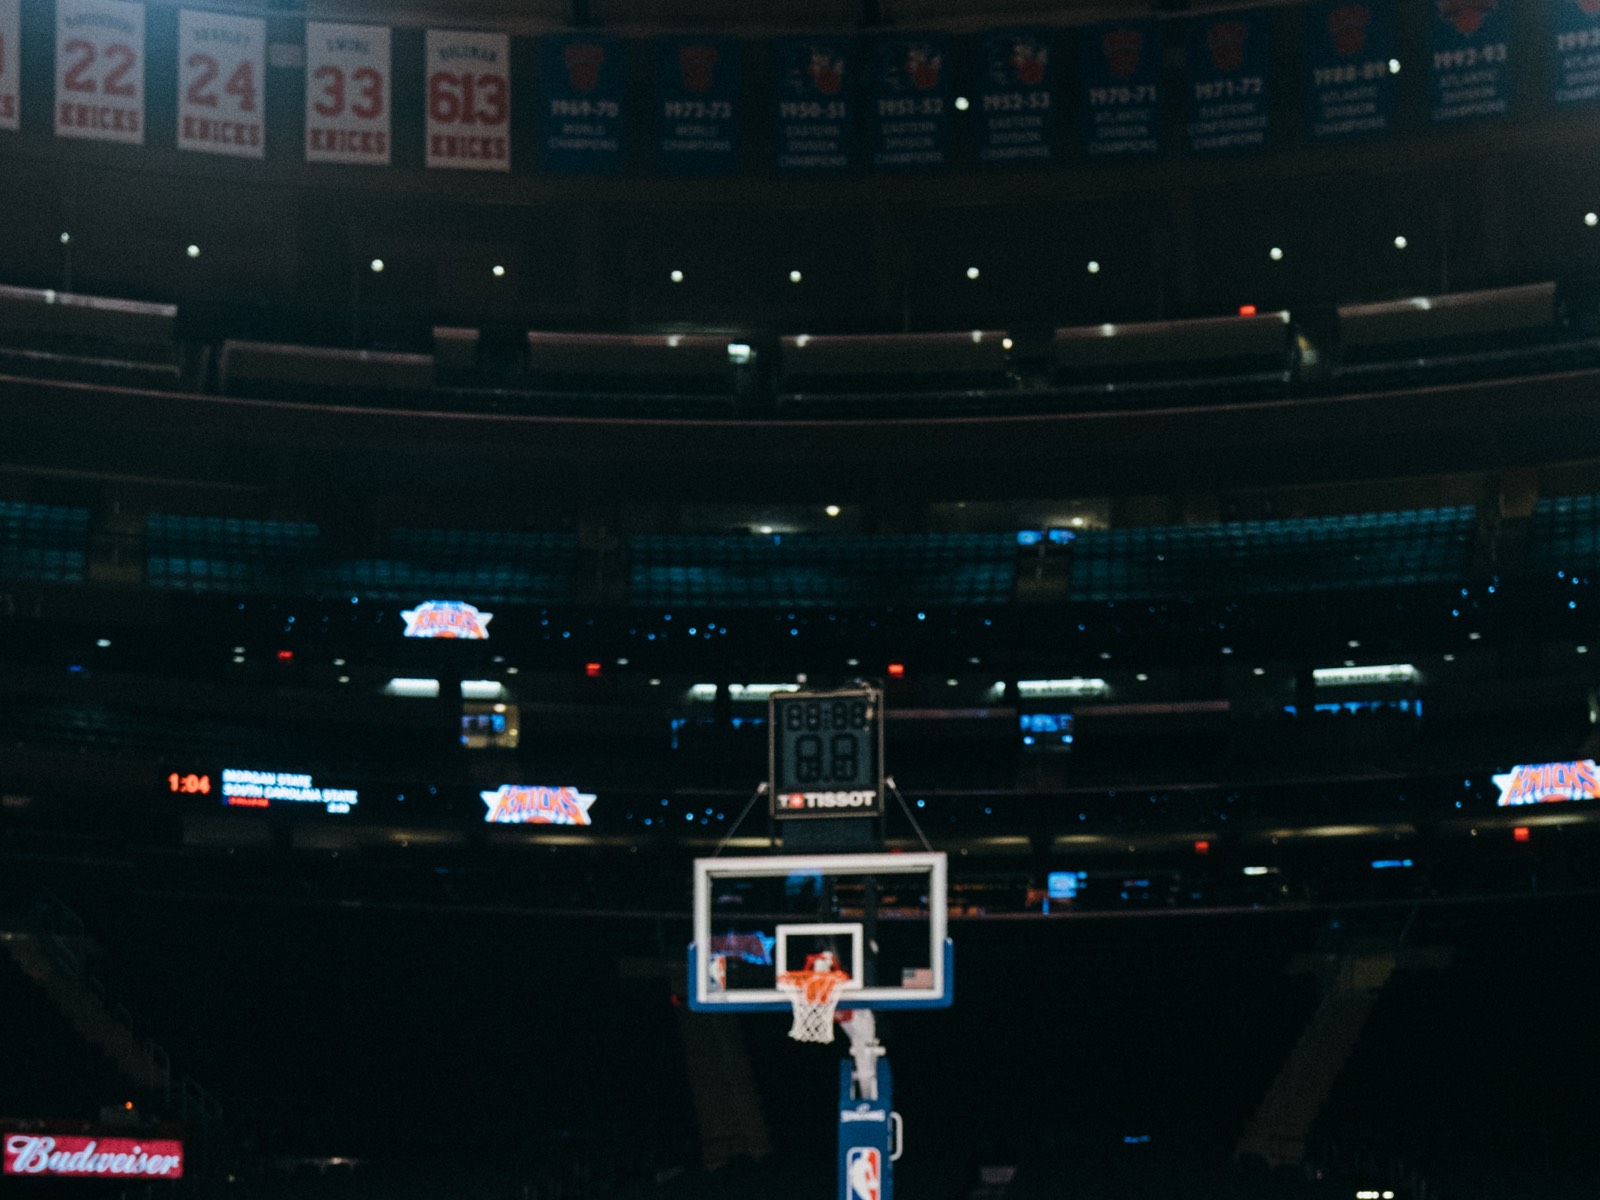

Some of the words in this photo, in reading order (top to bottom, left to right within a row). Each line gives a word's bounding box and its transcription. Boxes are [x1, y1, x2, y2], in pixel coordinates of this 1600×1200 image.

[65, 40, 136, 97] 22
[187, 53, 256, 111] 24
[314, 65, 383, 118] 33
[430, 72, 508, 125] 613
[310, 129, 386, 154] KNICKS
[431, 135, 506, 159] KNICKS
[168, 773, 211, 795] 1:04
[804, 790, 876, 809] TISSOT
[7, 1135, 180, 1175] Budweiser
